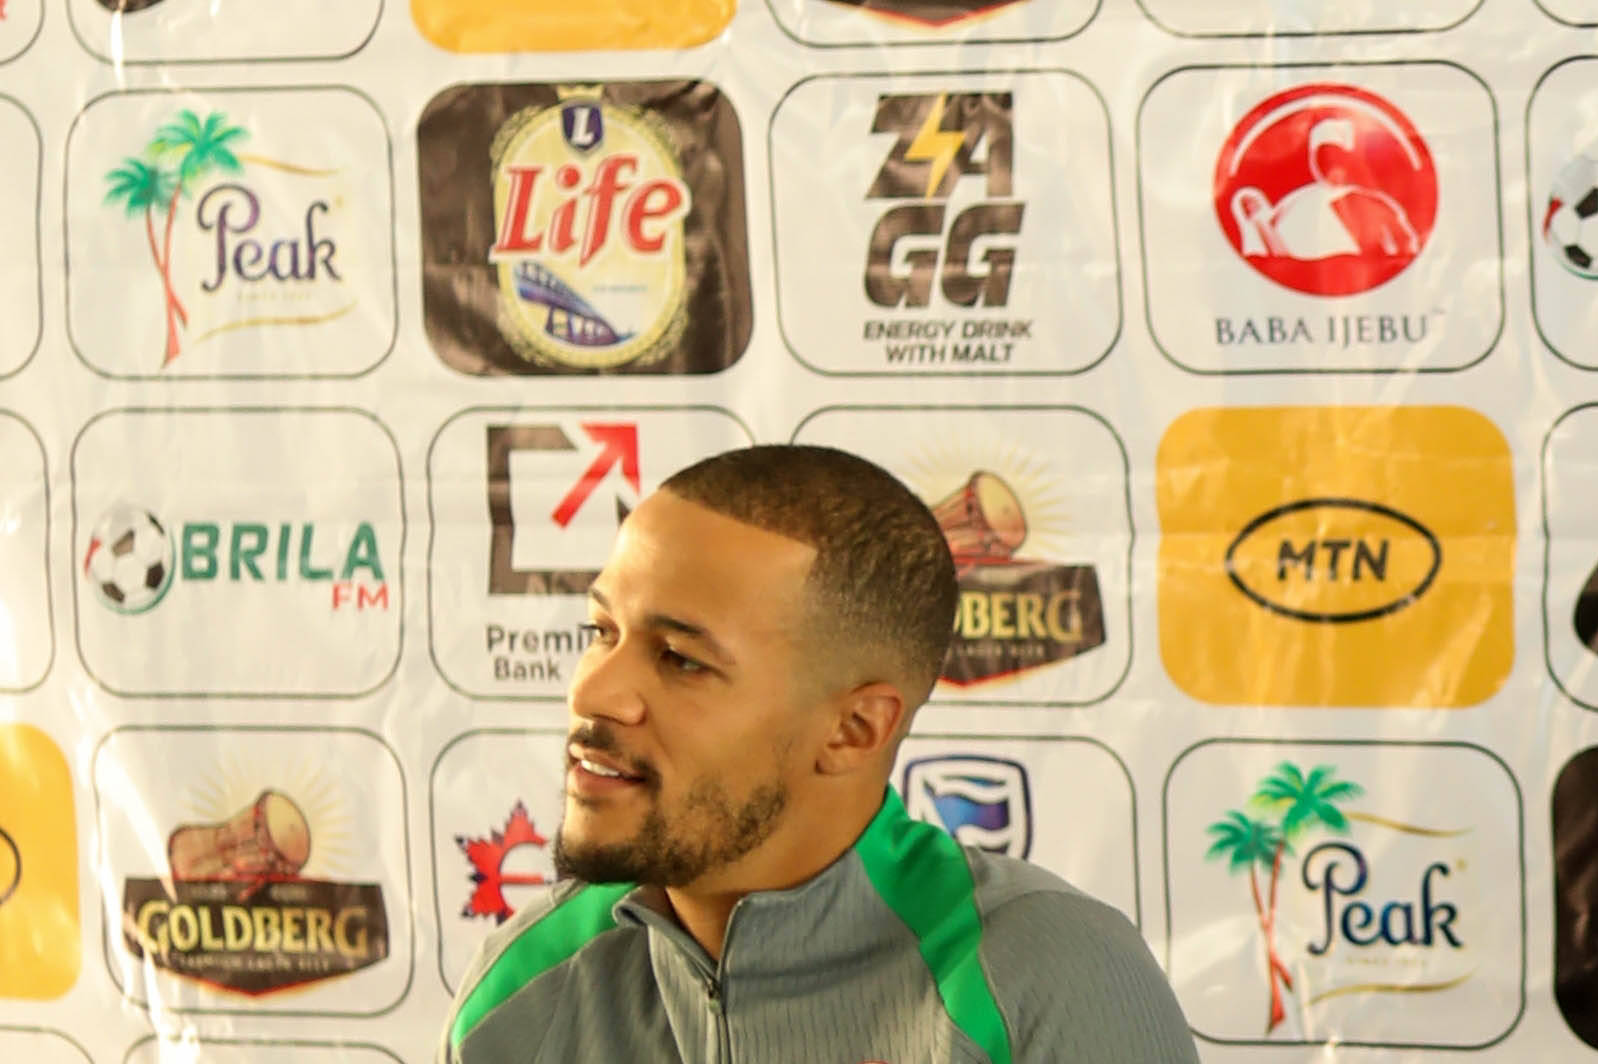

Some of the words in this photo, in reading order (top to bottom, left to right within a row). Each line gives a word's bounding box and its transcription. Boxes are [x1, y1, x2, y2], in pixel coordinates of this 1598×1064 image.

[197, 183, 342, 292] Peak
[494, 155, 684, 268] Life
[864, 202, 1026, 309] GG
[863, 319, 956, 342] ENERGY
[962, 320, 1034, 339] DRINK
[886, 343, 948, 364] WITH
[952, 342, 1016, 362] MALT
[1215, 317, 1312, 346] BABA
[1326, 312, 1430, 348] IJEBU
[181, 523, 385, 581] BRILA
[1276, 540, 1389, 582] MTN
[333, 583, 388, 611] FM
[954, 589, 1082, 643] BERG
[494, 658, 561, 681] Bank
[1302, 842, 1462, 956] Peak
[138, 901, 367, 957] GOLDBERG
